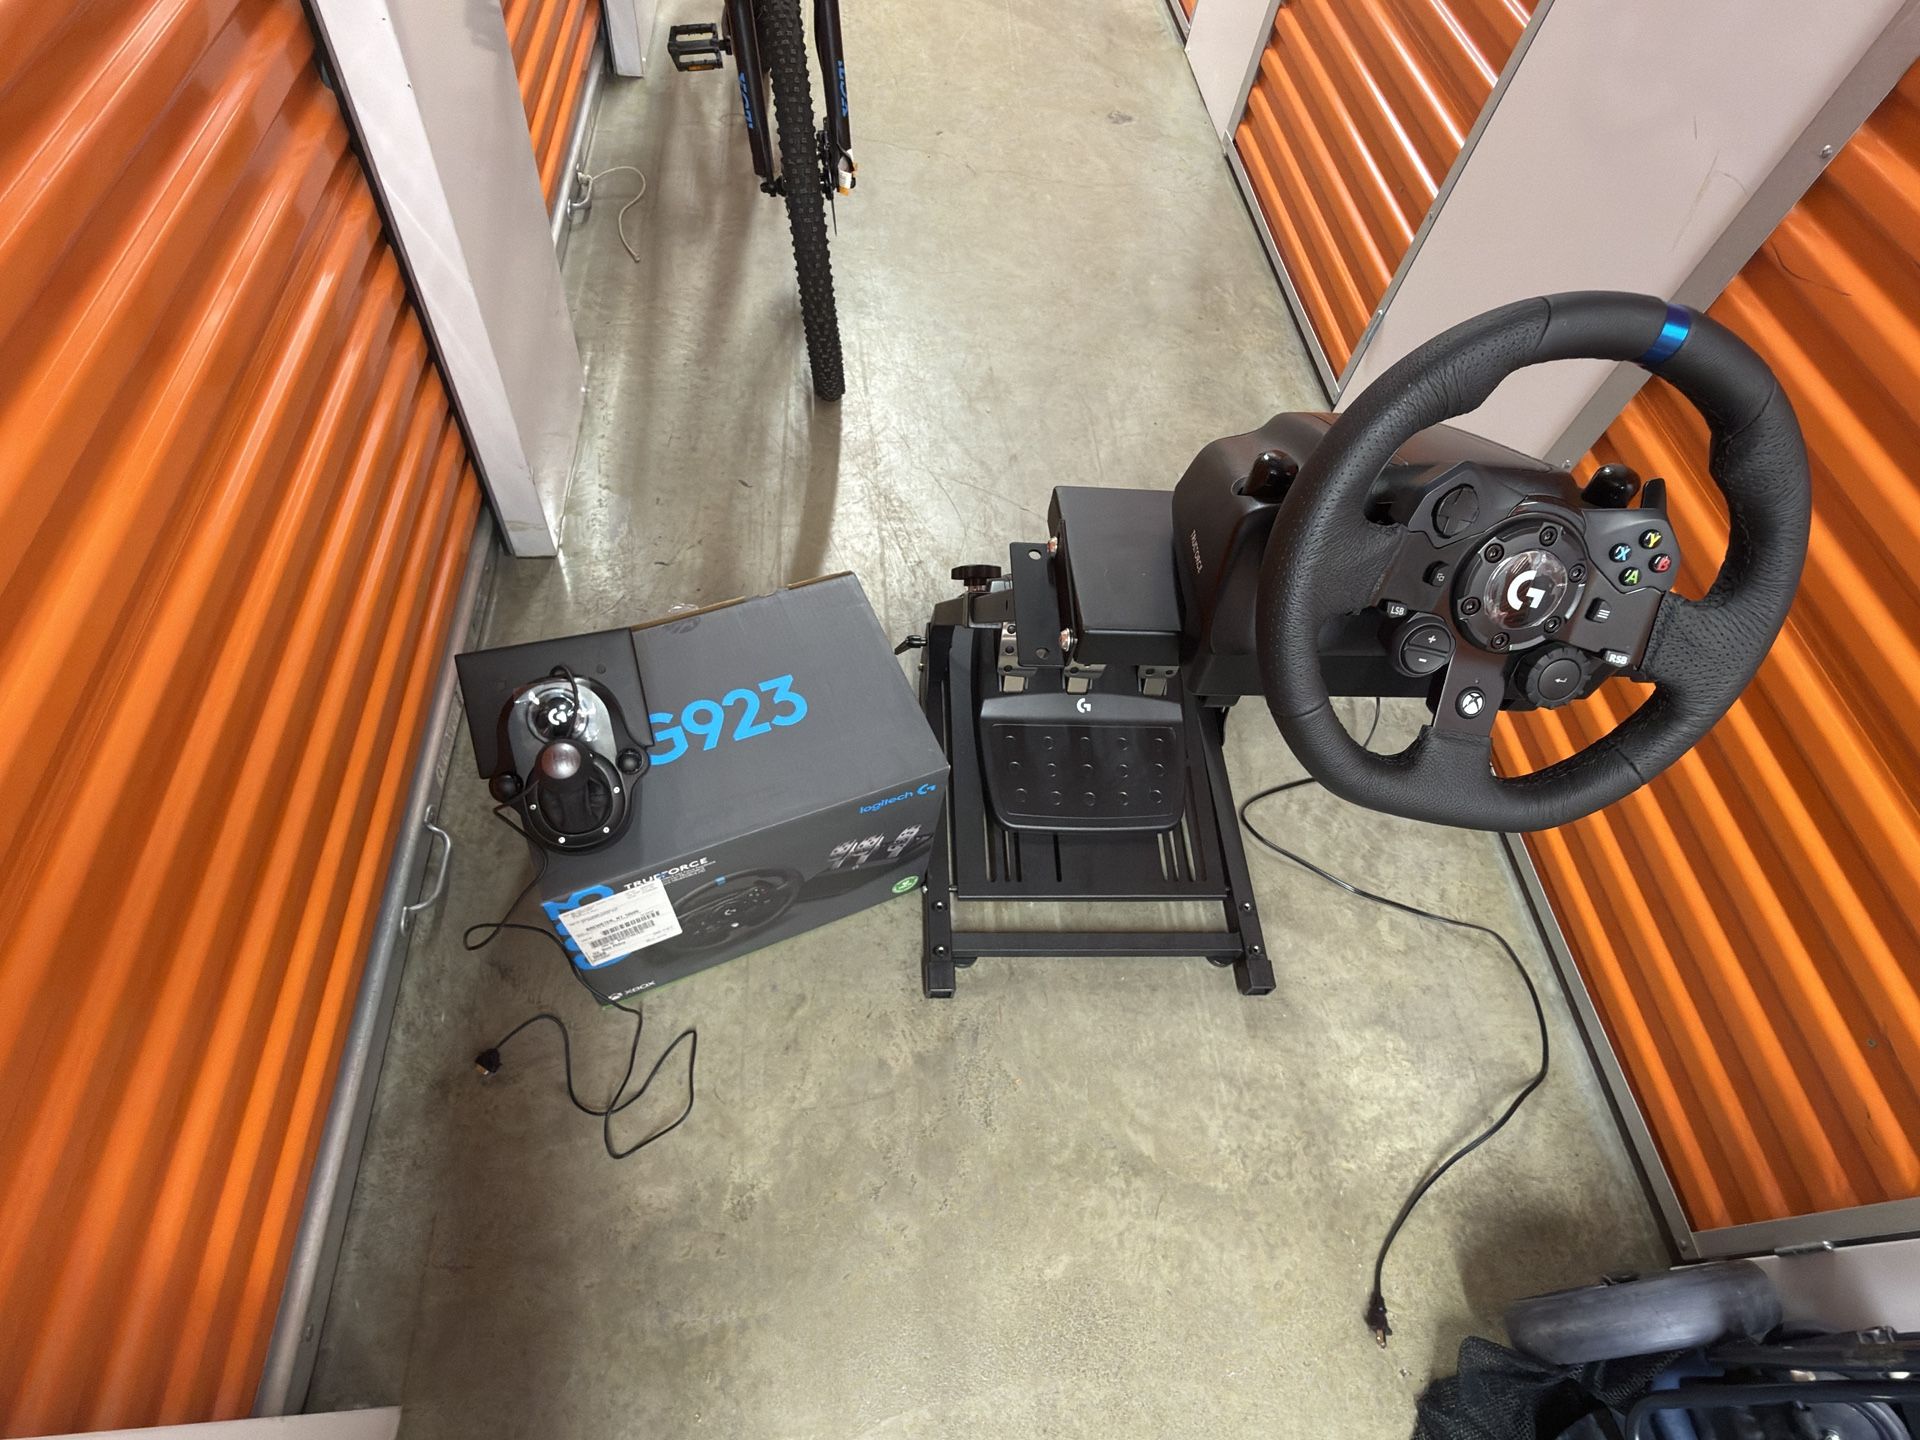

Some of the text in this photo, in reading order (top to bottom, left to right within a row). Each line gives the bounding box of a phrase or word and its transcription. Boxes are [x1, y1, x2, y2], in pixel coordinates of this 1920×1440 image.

[1648, 532, 1662, 548] Y
[1614, 546, 1631, 561] X
[1656, 556, 1671, 571] B
[1625, 569, 1639, 584] A
[1390, 605, 1404, 616] LSB
[1607, 653, 1628, 666] RSB
[648, 674, 808, 766] G923
[859, 791, 914, 814] logitech
[623, 856, 709, 890] TRUEFORCE
[624, 980, 656, 996] XBOX
